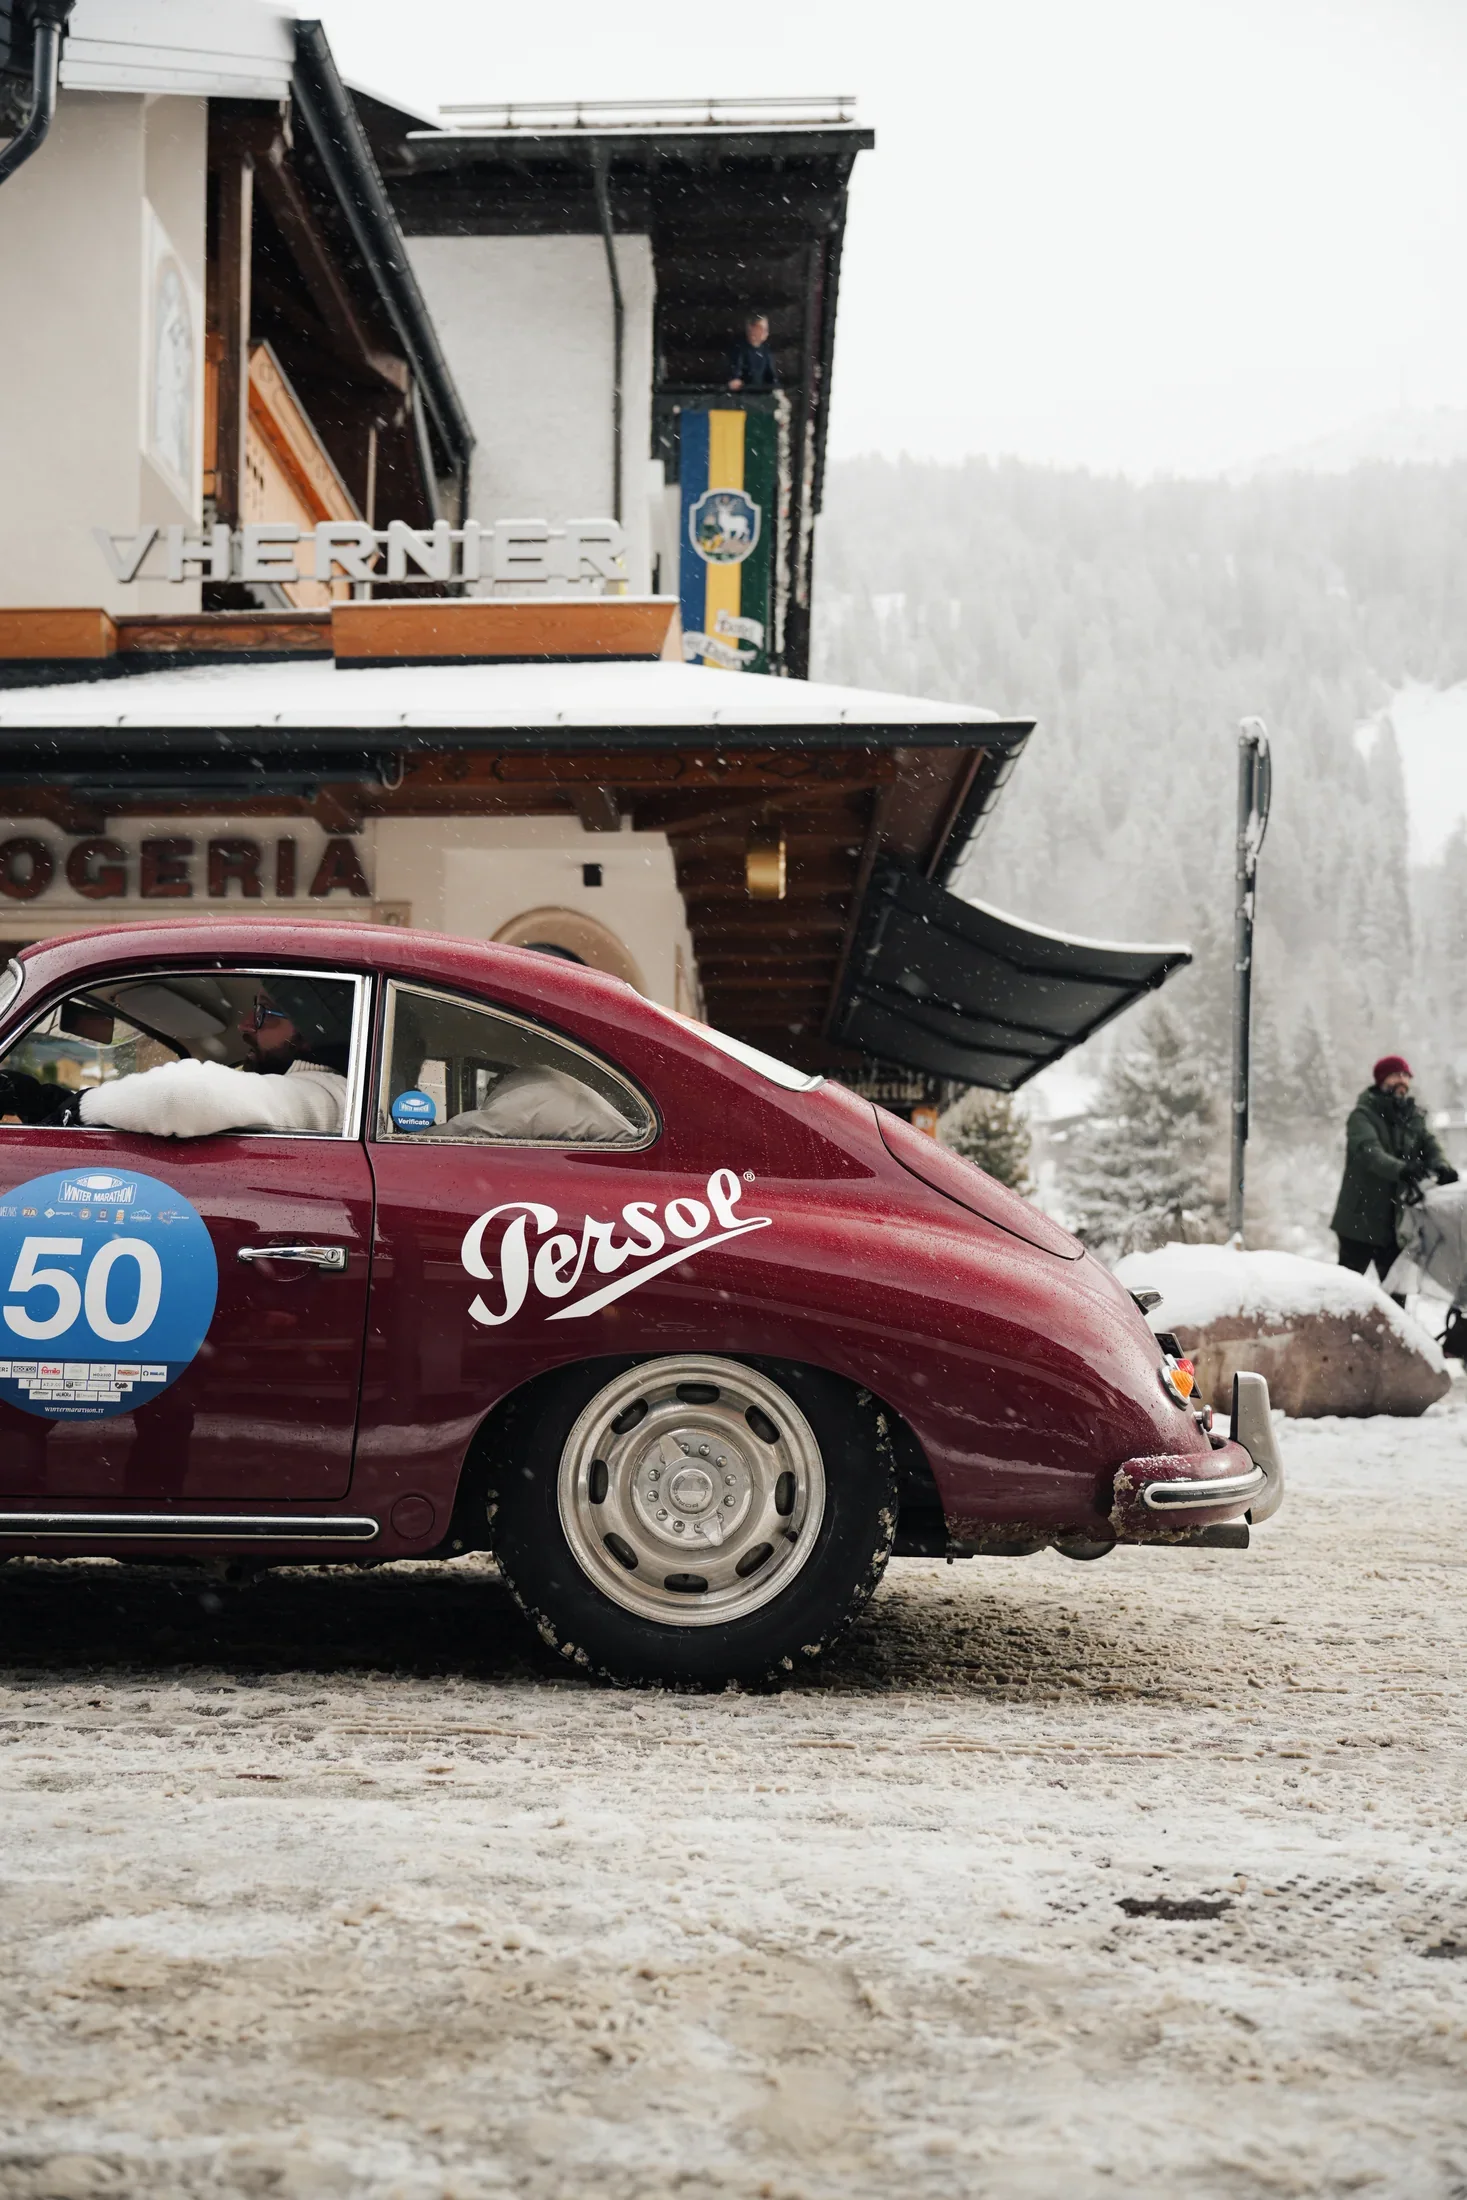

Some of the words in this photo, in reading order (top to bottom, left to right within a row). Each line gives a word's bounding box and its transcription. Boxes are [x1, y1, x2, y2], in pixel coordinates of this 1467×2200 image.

[92, 518, 630, 583] VHERNIER
[0, 837, 371, 899] OGERIA
[398, 1118, 430, 1126] Verificato
[23, 1208, 37, 1217] FIA
[63, 1182, 92, 1201] WINTER
[93, 1184, 134, 1203] MARATHON
[461, 1168, 773, 1325] Persol
[3, 1236, 162, 1342] 50
